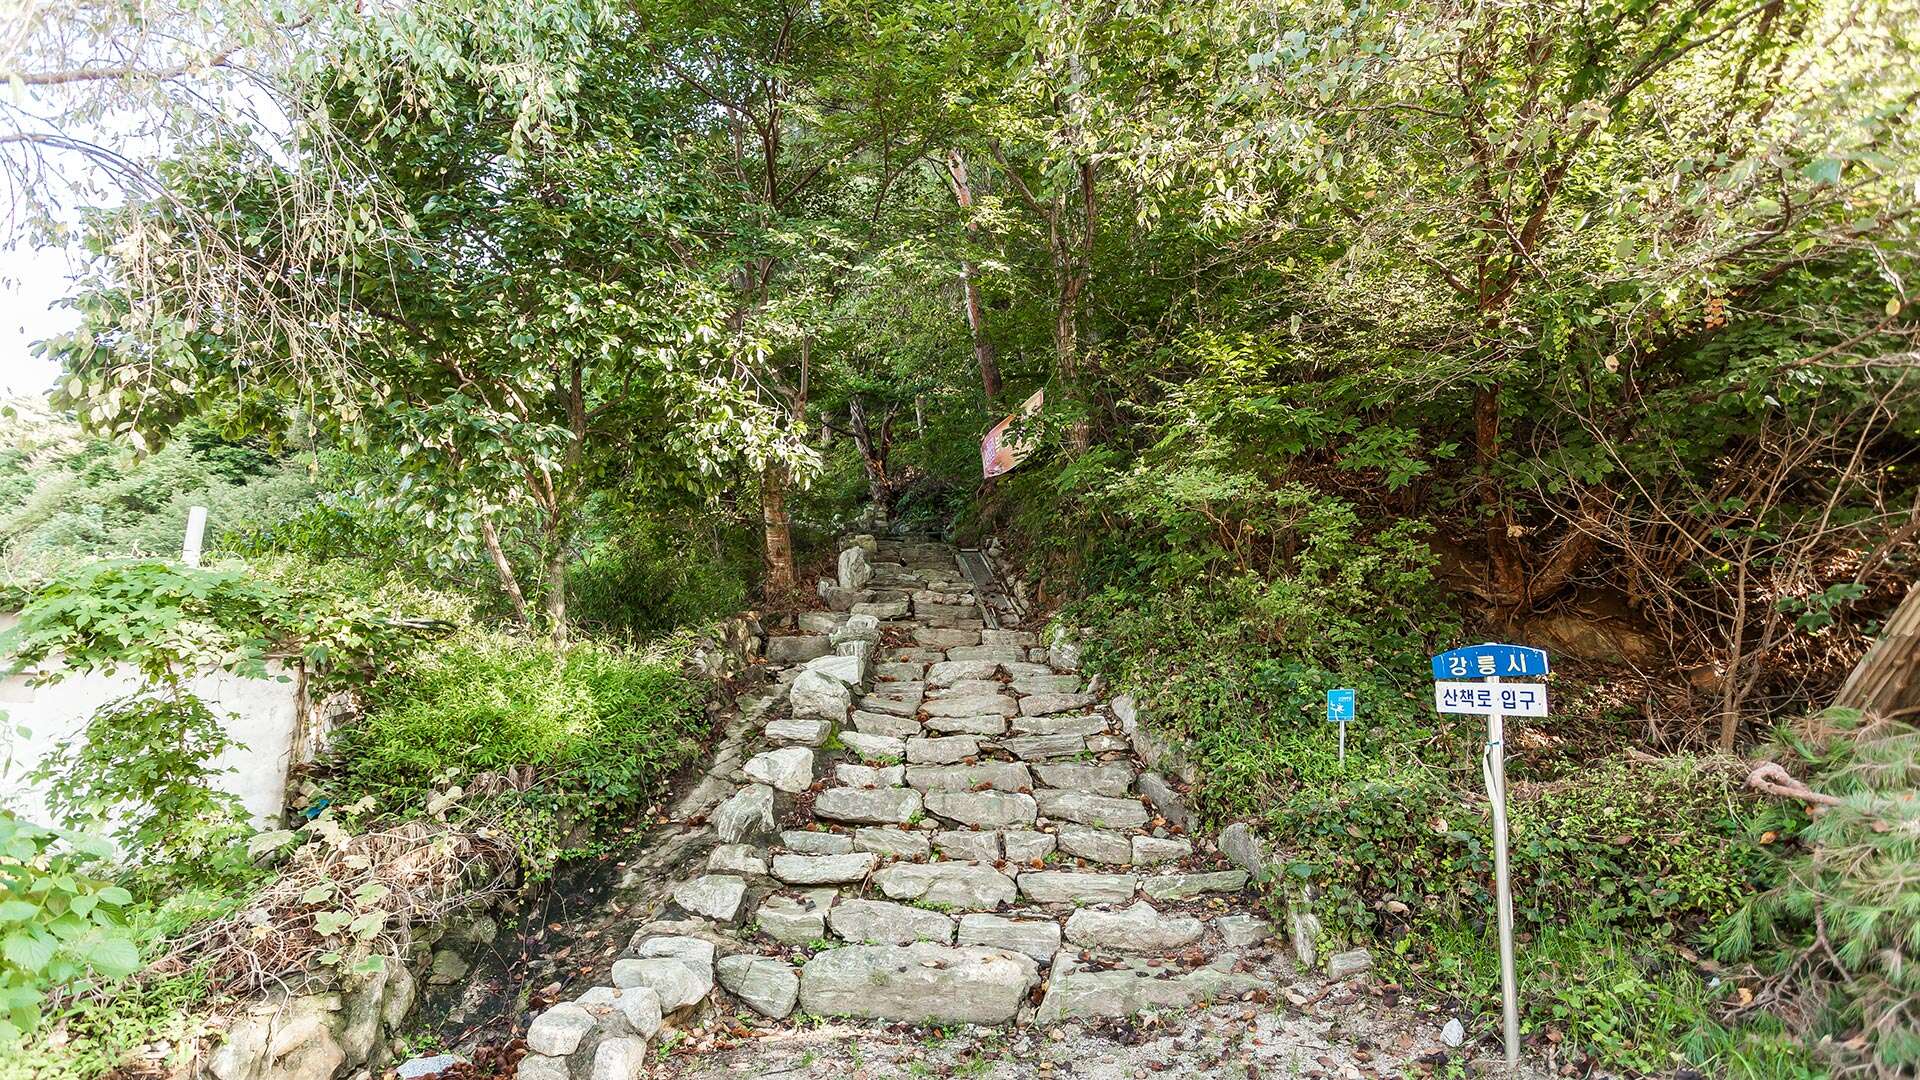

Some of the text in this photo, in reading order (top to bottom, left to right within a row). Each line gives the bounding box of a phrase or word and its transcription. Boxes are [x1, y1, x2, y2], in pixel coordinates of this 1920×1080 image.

[1448, 653, 1527, 675] 강릉시
[1443, 688, 1535, 710] 산책로 입구
